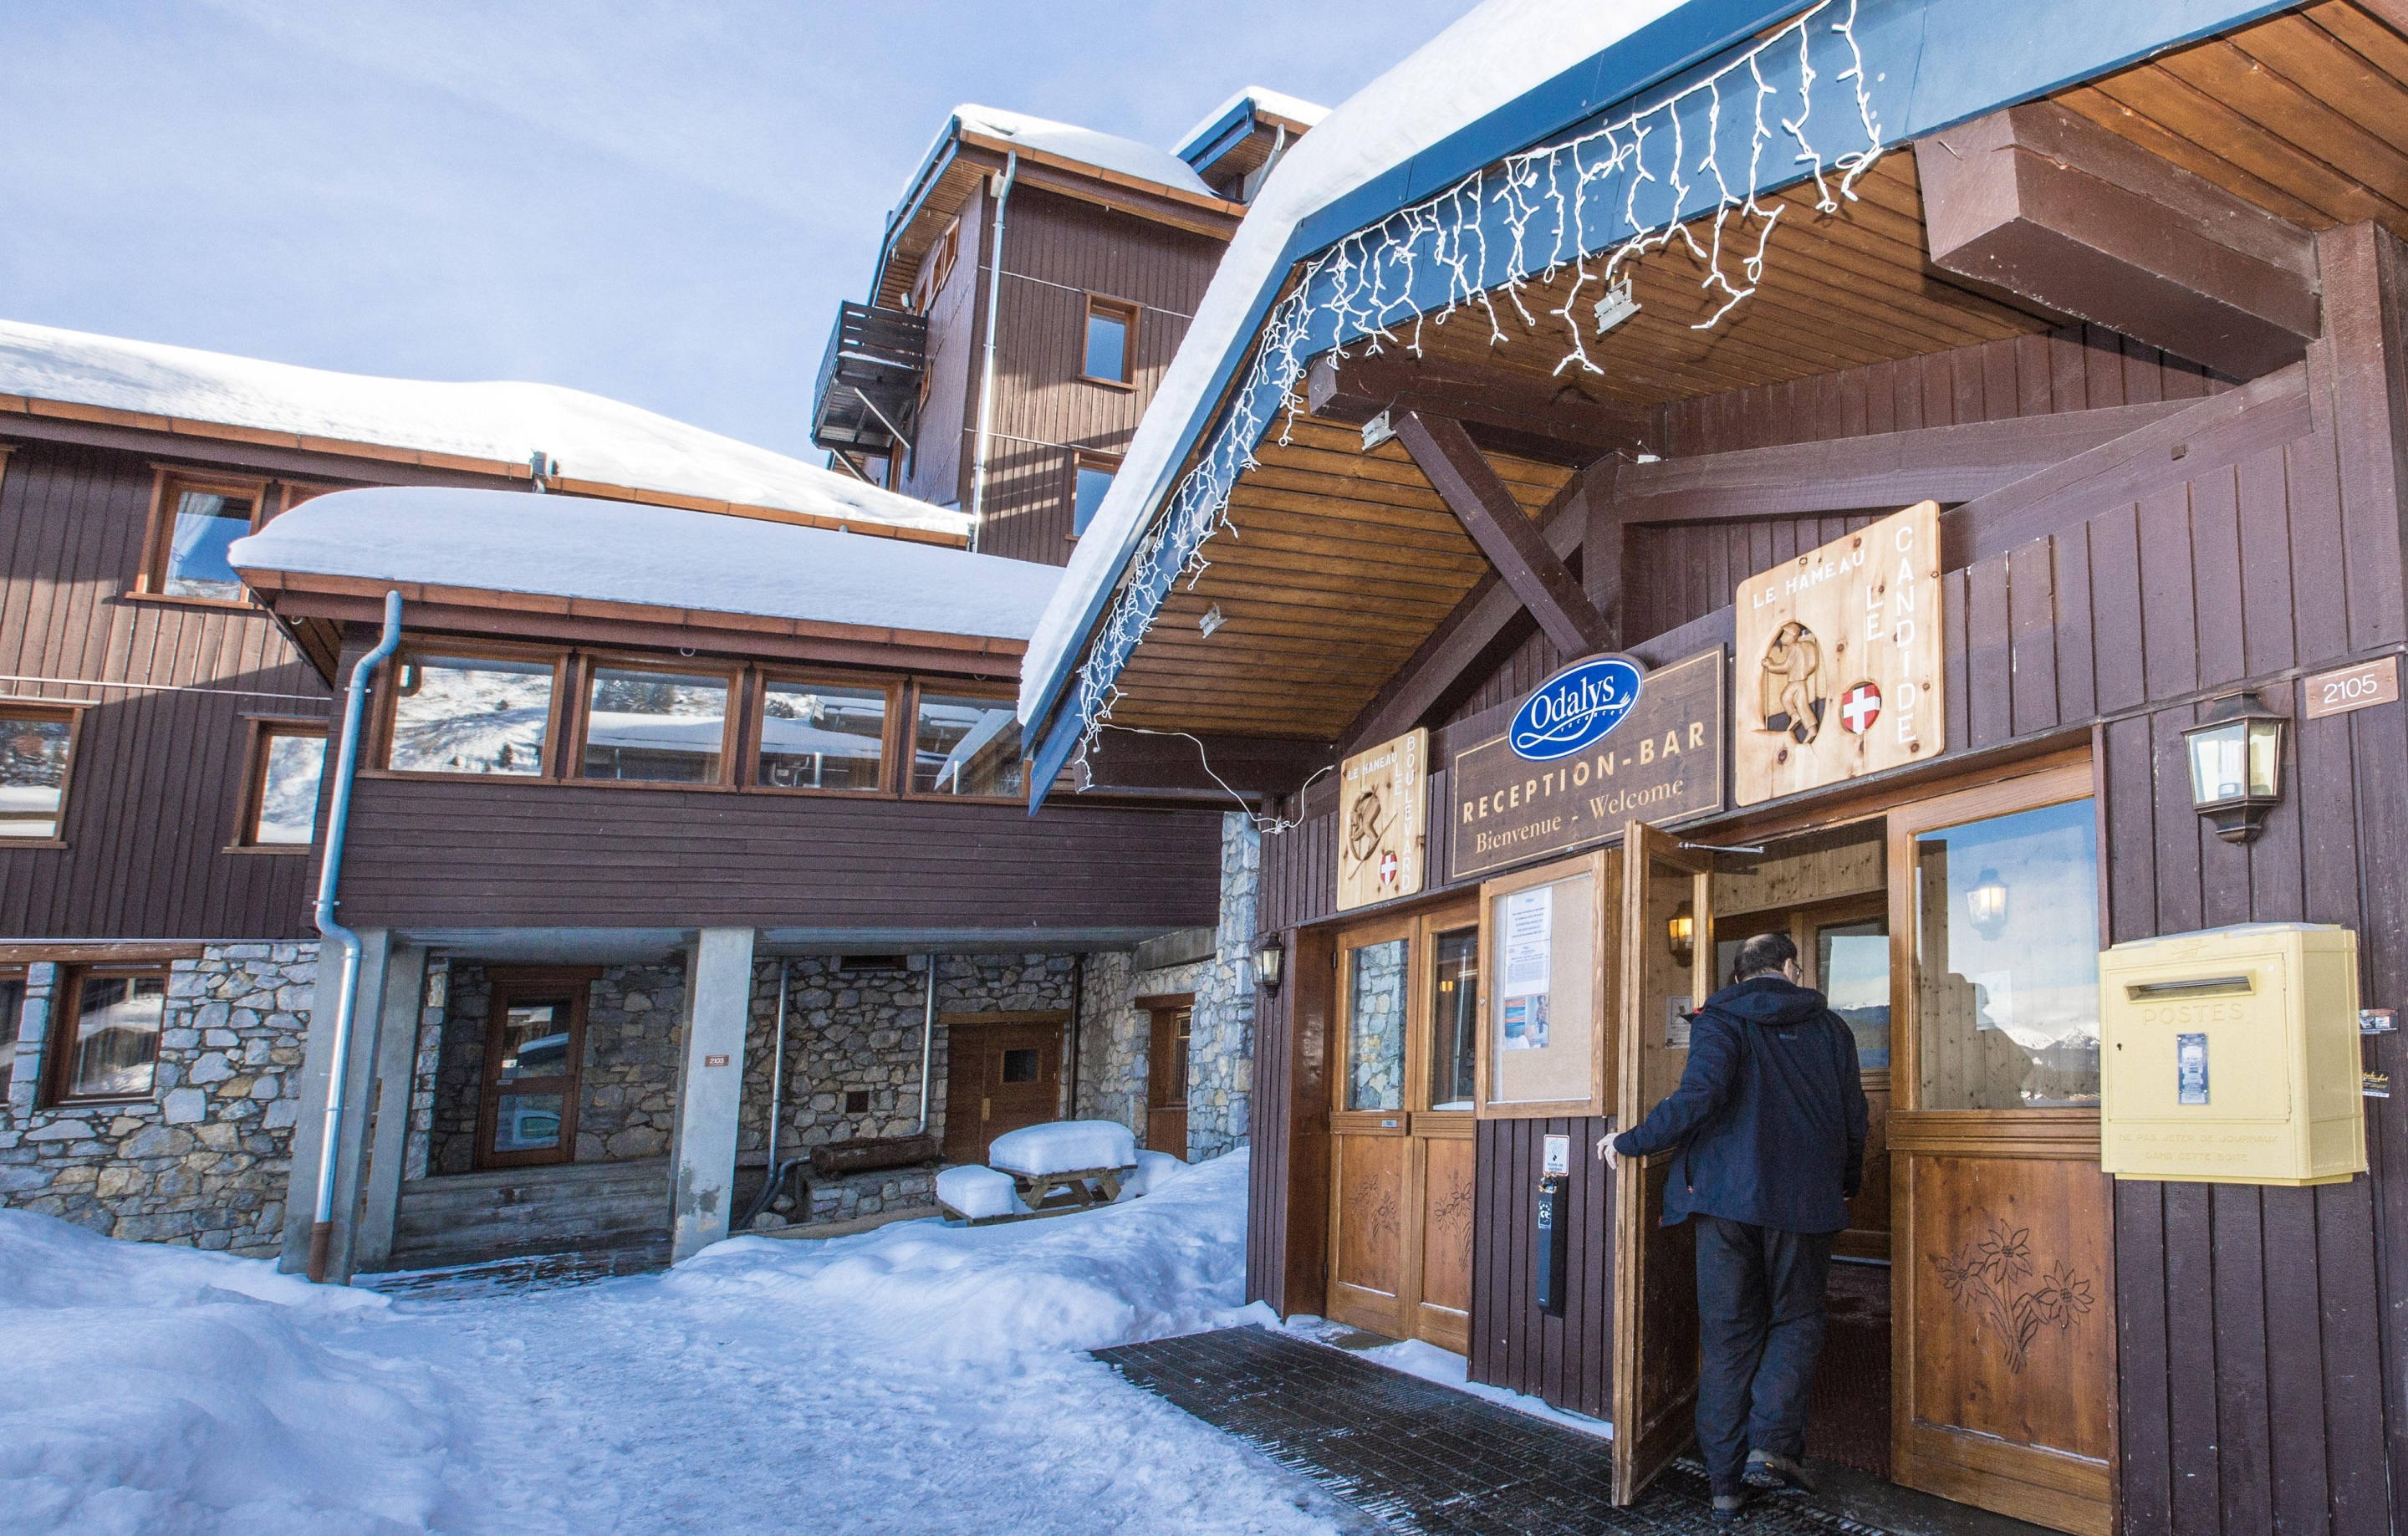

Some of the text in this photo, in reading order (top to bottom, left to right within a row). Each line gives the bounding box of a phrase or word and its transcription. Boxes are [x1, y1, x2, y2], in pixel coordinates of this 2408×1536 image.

[1752, 549, 1865, 610] LE HAMEAU
[1865, 584, 1885, 641] LE
[1895, 525, 1917, 744] CANDIDE
[1531, 676, 1615, 729] Odalys
[2324, 673, 2378, 704] 2105
[1560, 709, 1623, 732] vacances
[1347, 751, 1398, 782] LE HAMEAU
[1394, 762, 1403, 795] LE
[1462, 722, 1705, 824] RECEPTION-BAR
[1401, 735, 1416, 891] BOULEVARD
[1475, 814, 1561, 855] Bienvenue
[1589, 778, 1684, 820] Welcome
[2142, 1003, 2243, 1025] POSTES
[2136, 1134, 2155, 1142] PAS
[2163, 1134, 2195, 1142] JETER
[2200, 1134, 2213, 1143] DE
[2220, 1134, 2278, 1144] JOURNAUX
[2145, 1151, 2172, 1161] DANS
[2178, 1152, 2211, 1161] CETTE
